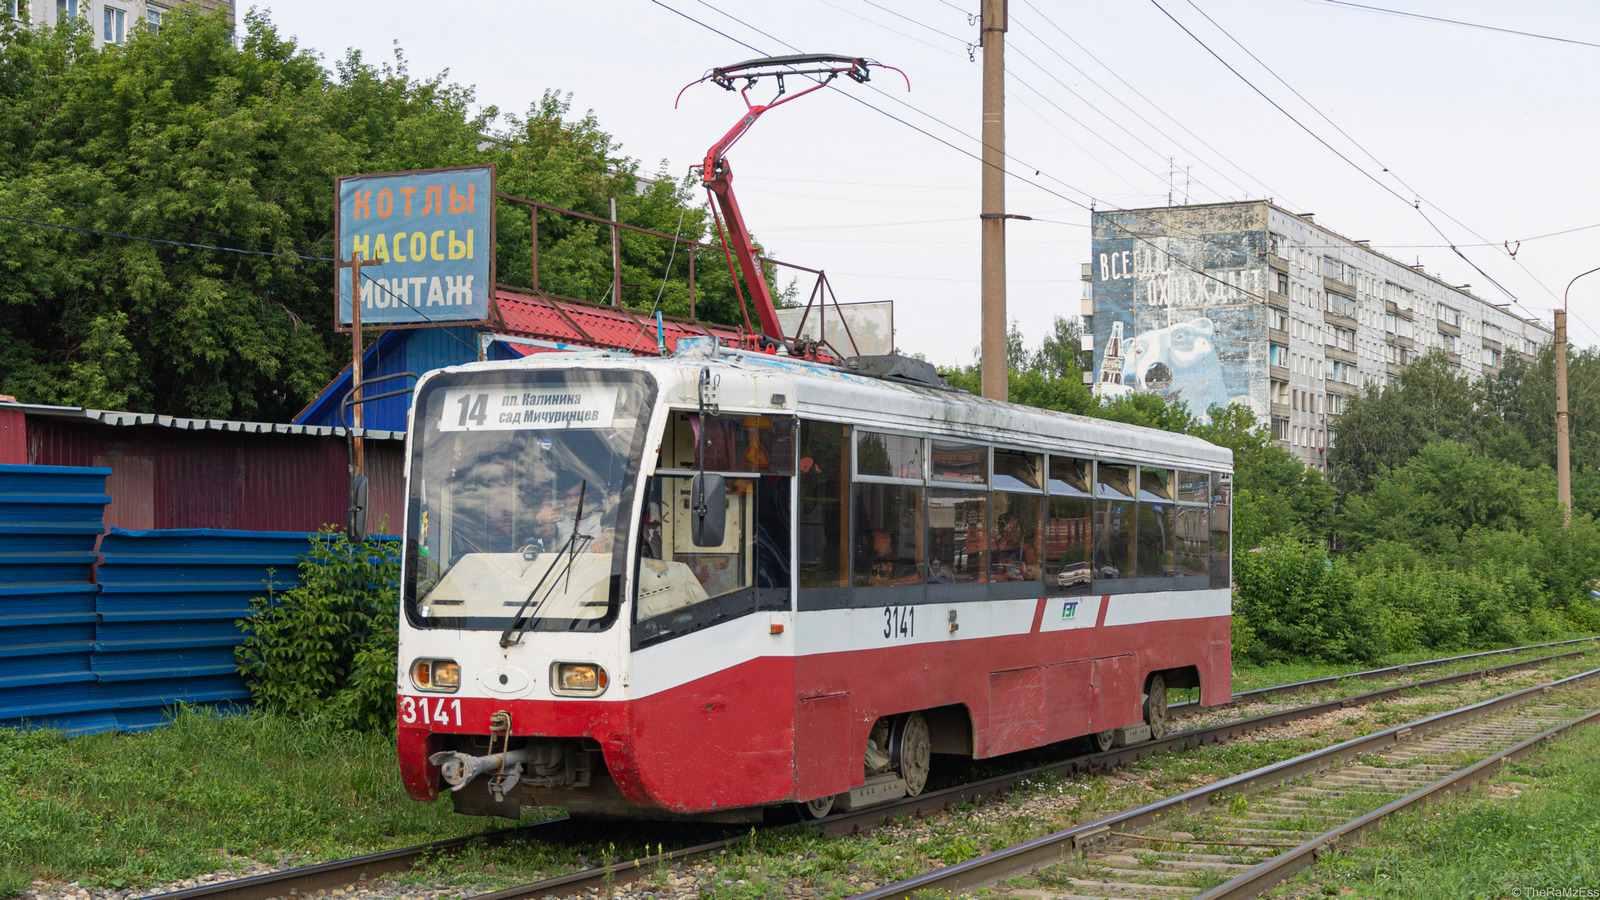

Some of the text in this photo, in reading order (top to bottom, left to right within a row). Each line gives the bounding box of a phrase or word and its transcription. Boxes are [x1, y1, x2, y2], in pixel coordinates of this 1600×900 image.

[353, 183, 475, 220] КОТЛЫ
[353, 229, 474, 263] НАСОСЫ
[457, 393, 490, 427] 14
[499, 409, 599, 424] сад Мичуринцев
[501, 393, 582, 407] пл. Калинина
[883, 606, 915, 639] 3141
[402, 696, 463, 727] 3141
